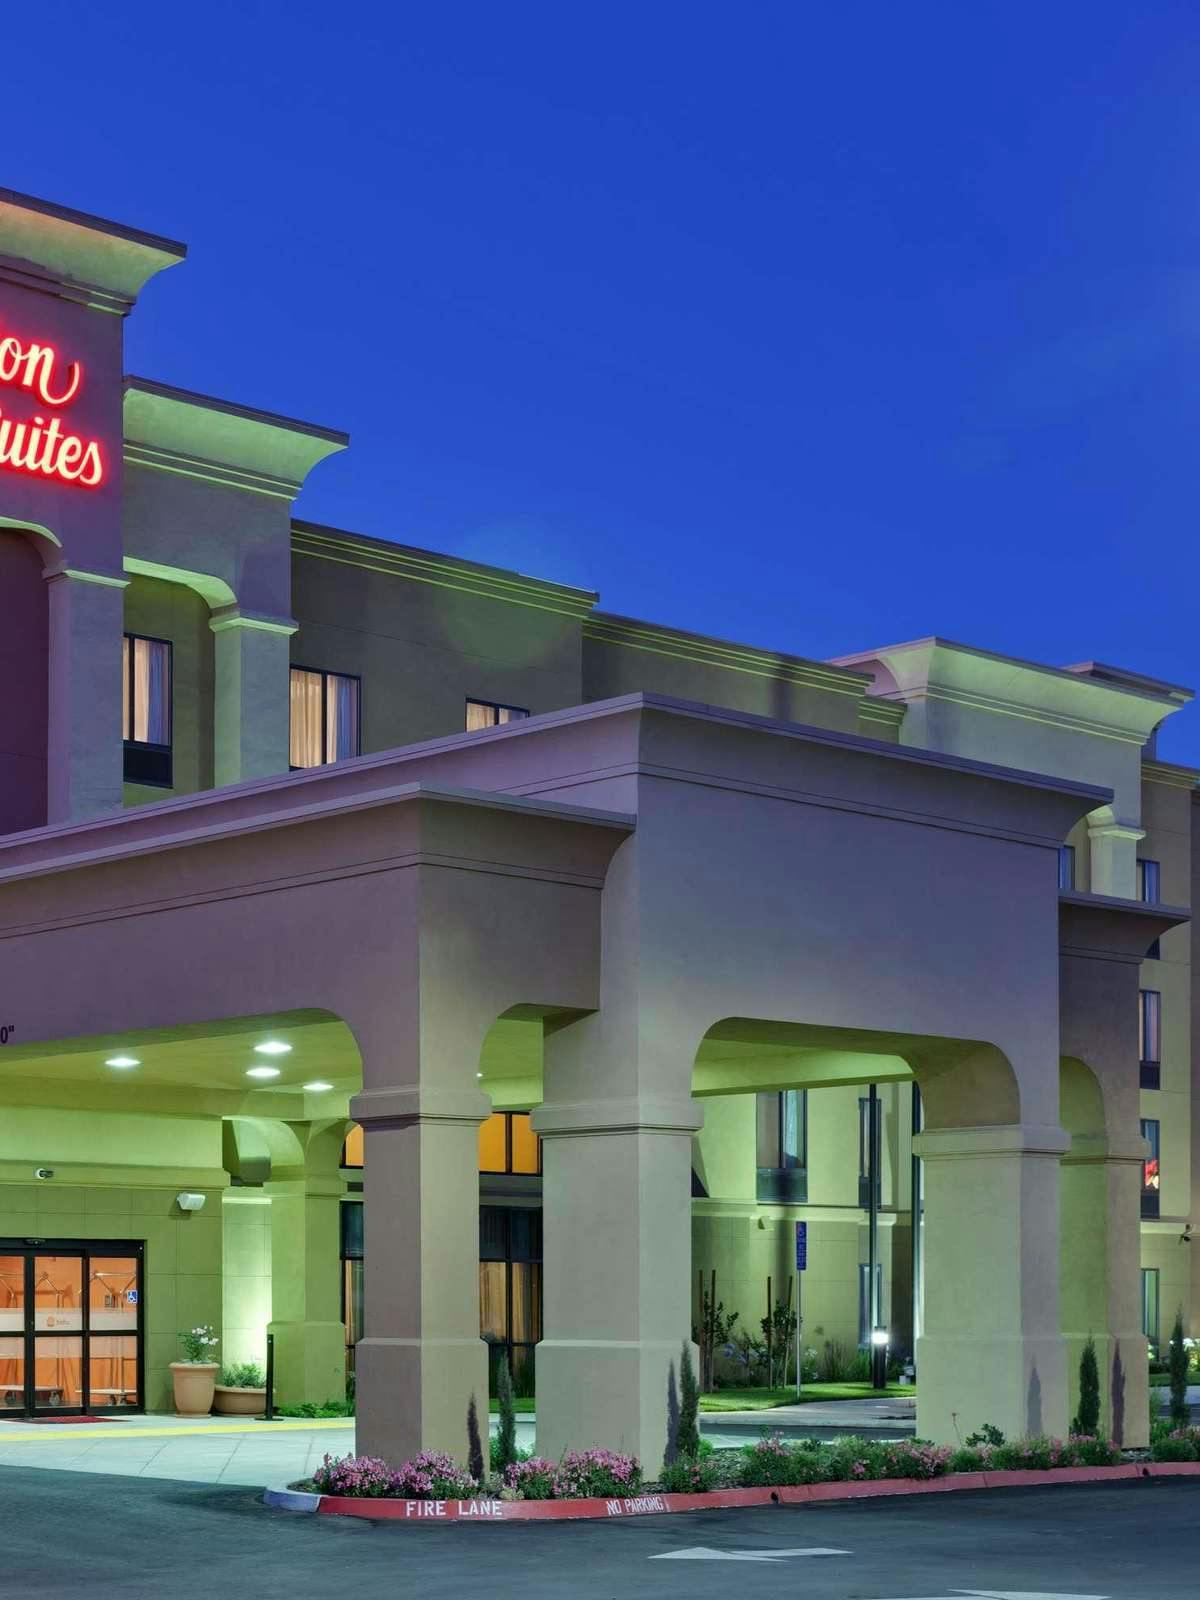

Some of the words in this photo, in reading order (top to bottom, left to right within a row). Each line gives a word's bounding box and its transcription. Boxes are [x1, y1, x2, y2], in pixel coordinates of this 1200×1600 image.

[0, 1024, 15, 1045] 0"
[406, 1500, 447, 1518] FIRE
[458, 1500, 503, 1516] LANE
[606, 1499, 622, 1517] NO
[624, 1496, 664, 1514] PARKING
